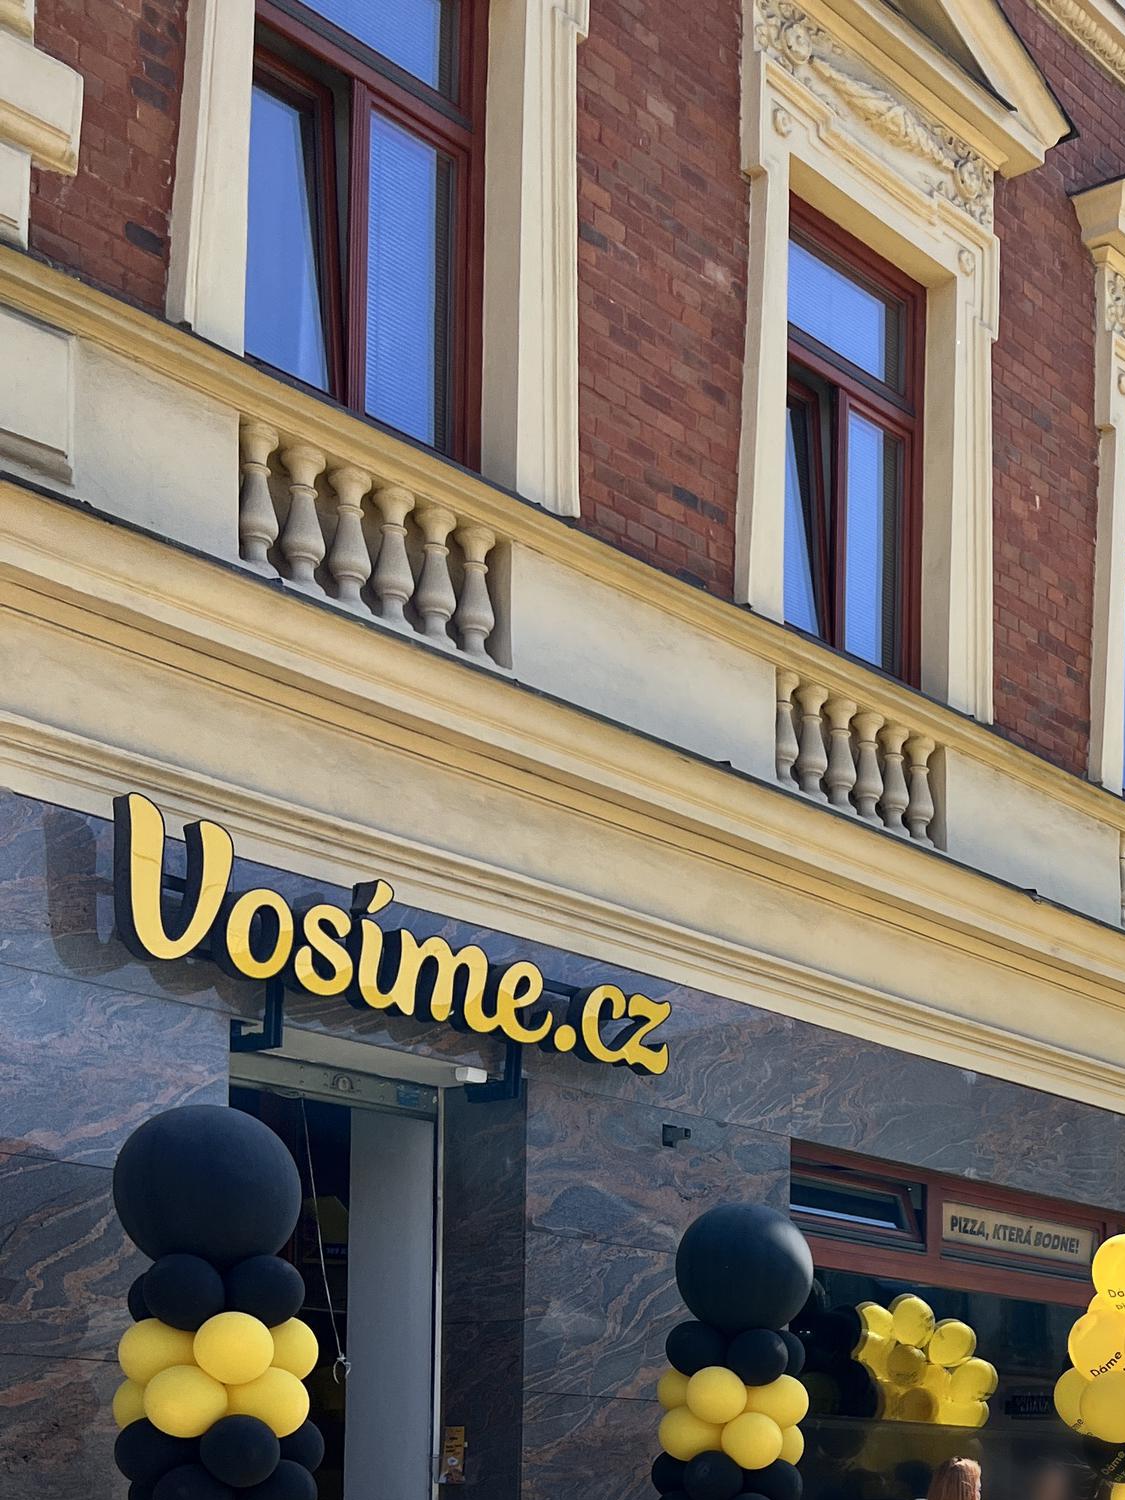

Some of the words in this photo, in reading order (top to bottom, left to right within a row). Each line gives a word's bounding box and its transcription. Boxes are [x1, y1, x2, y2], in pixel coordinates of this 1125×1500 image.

[113, 791, 673, 1077] Vosíme.cz
[950, 1214, 991, 1241] PIZZA,
[992, 1223, 1032, 1246] KTERÁ
[1033, 1231, 1081, 1255] BODNE!
[1089, 1350, 1123, 1379] Dáme
